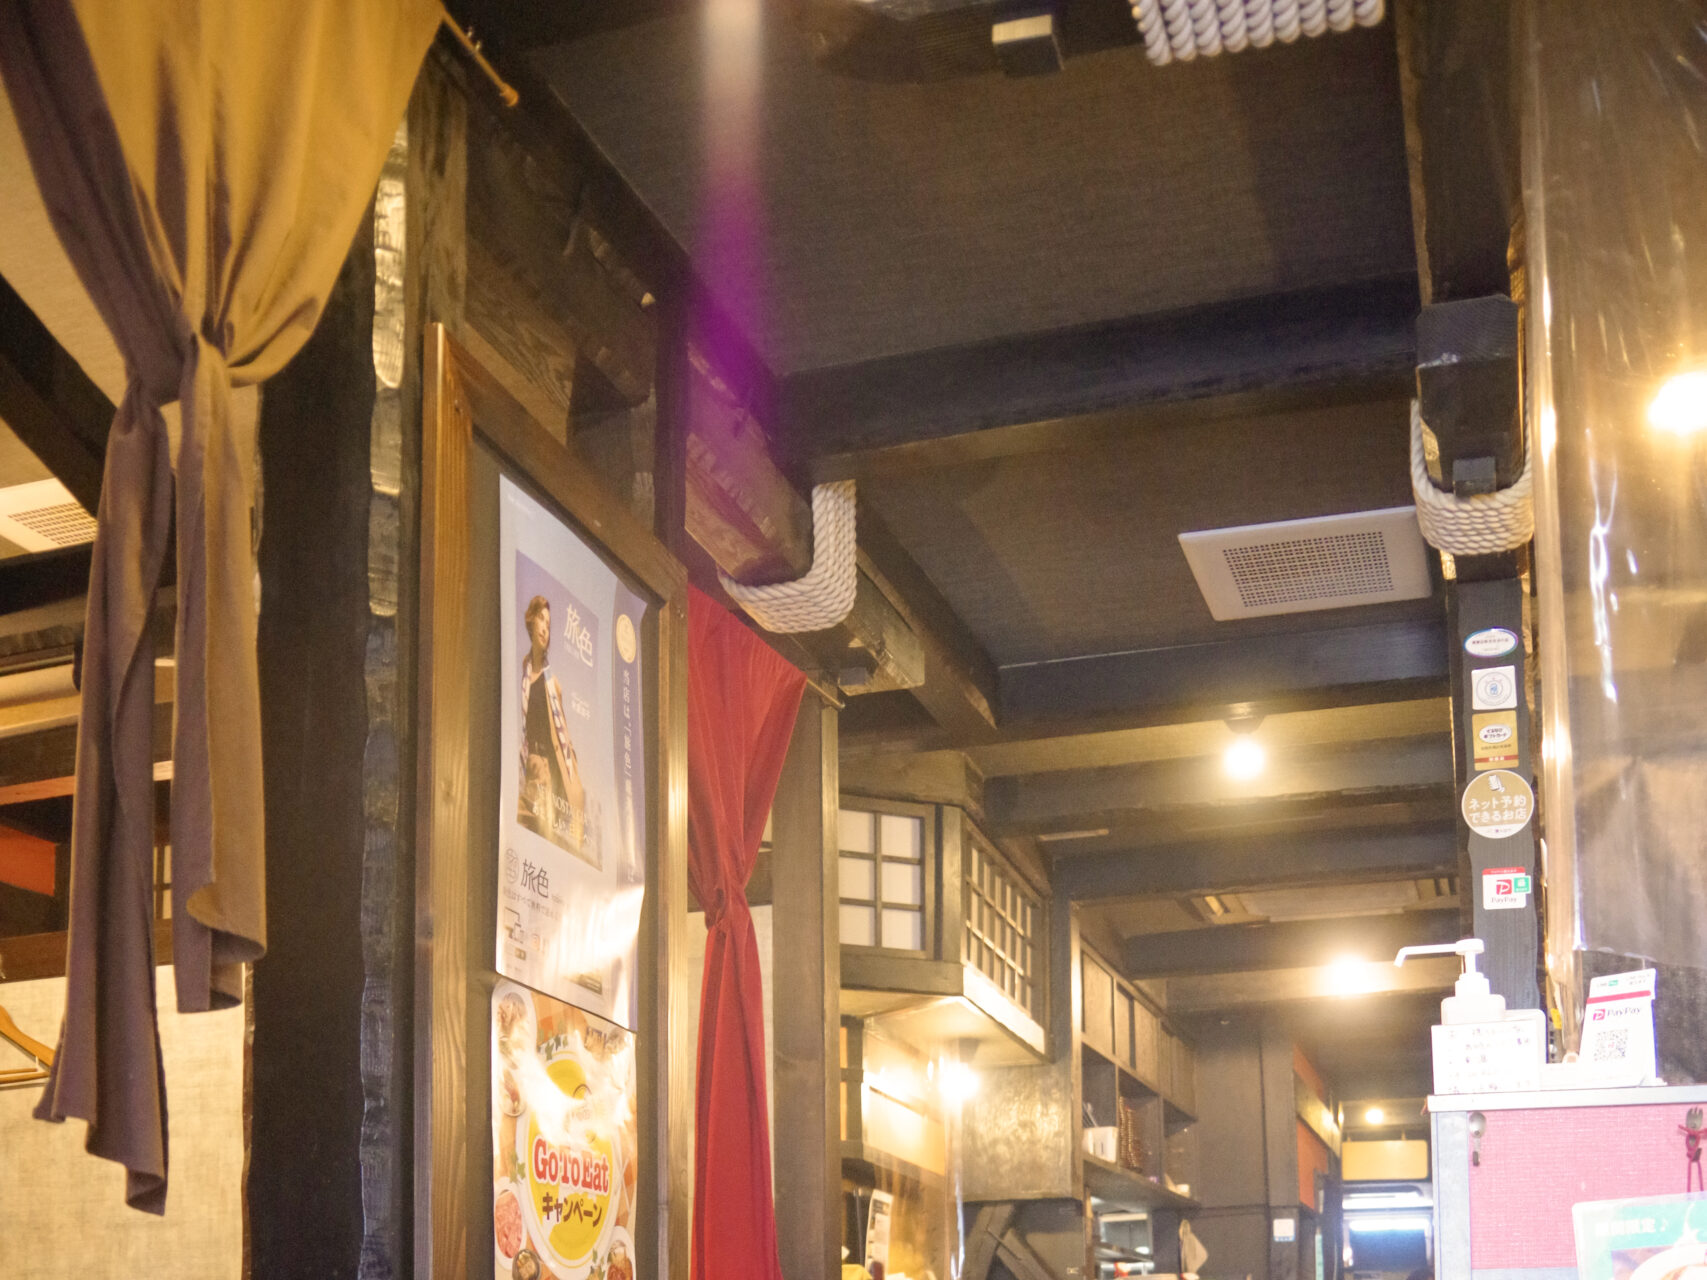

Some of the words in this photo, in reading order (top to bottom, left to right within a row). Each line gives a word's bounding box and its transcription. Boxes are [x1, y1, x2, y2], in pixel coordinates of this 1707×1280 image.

[563, 603, 594, 668] 旅色
[1468, 794, 1527, 810] ネット予約
[1469, 808, 1527, 823] できるお店
[520, 858, 550, 898] 旅色
[1606, 1006, 1641, 1018] PayPay
[542, 1192, 603, 1228] キャンペーン
